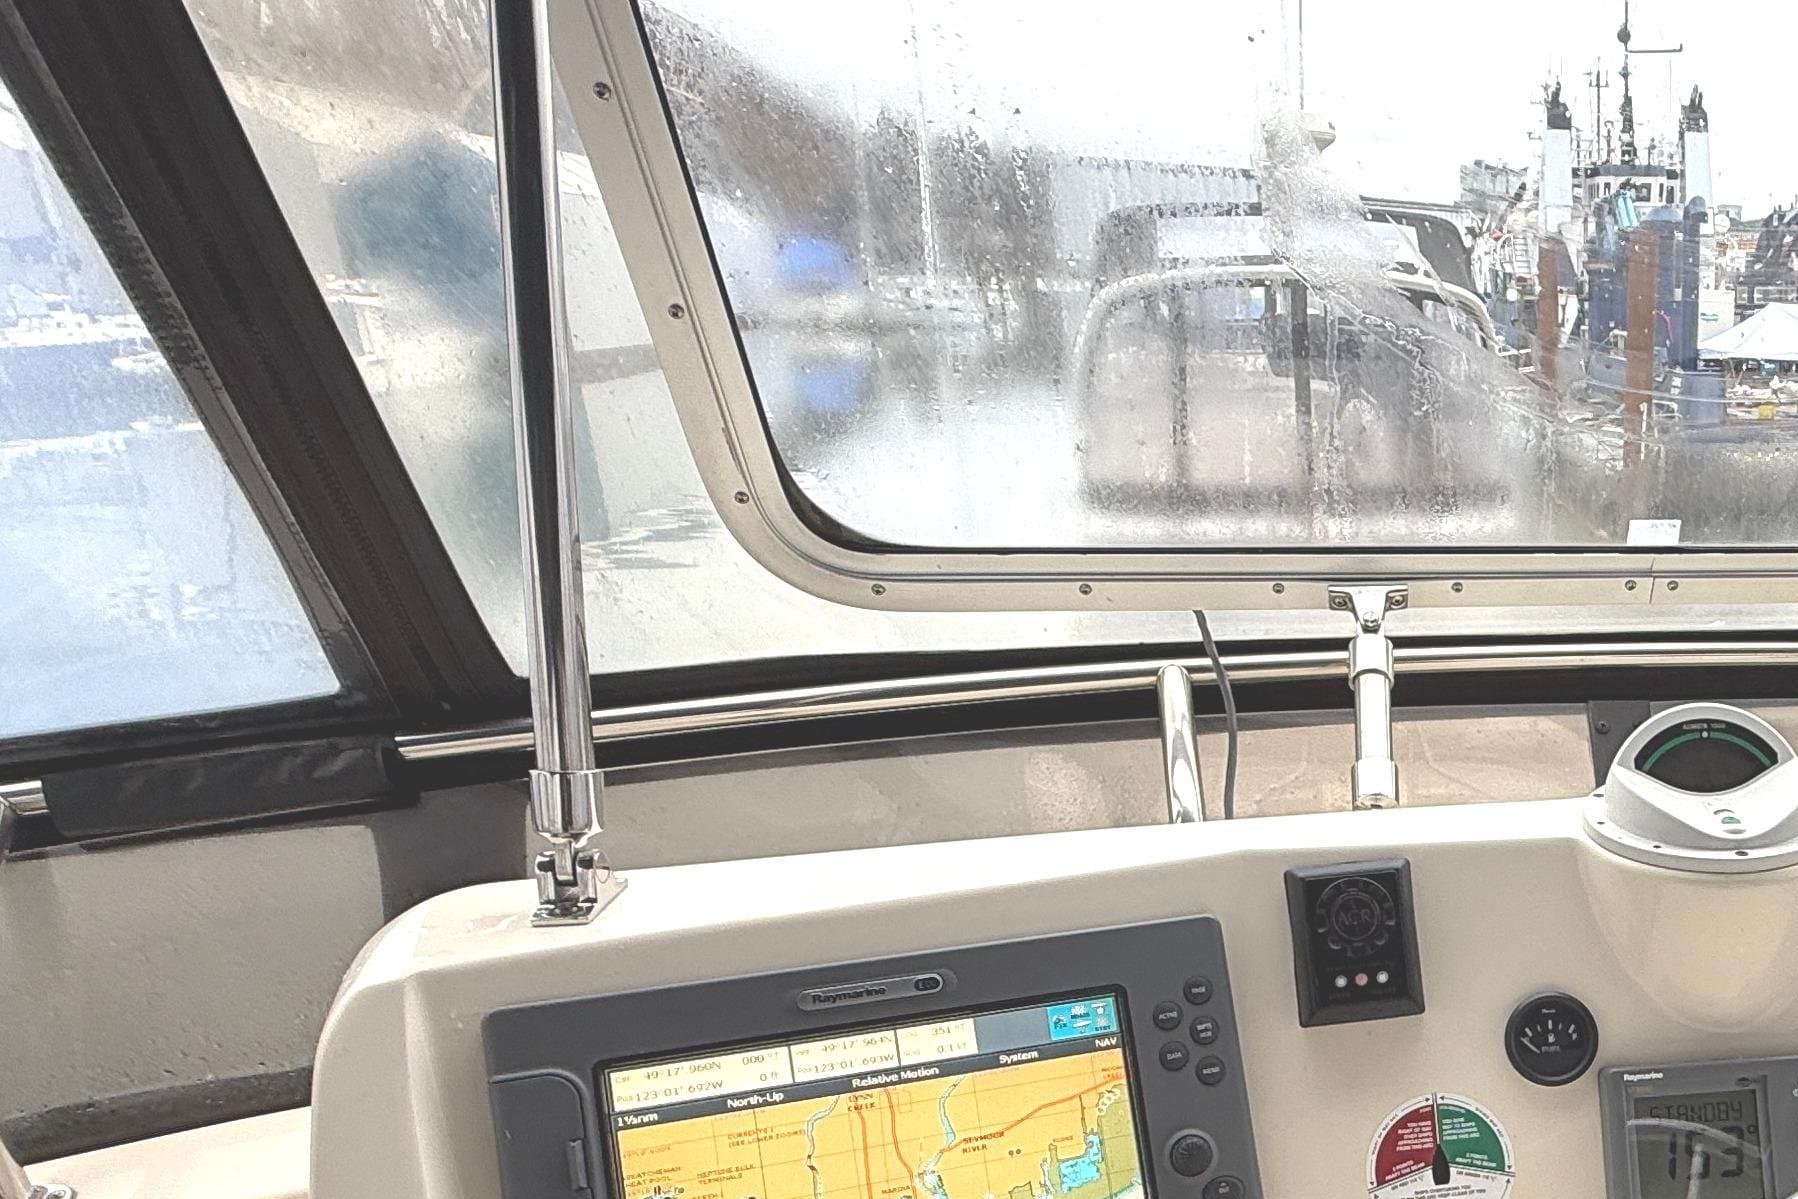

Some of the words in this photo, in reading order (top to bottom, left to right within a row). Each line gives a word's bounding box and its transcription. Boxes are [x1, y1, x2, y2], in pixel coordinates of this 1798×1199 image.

[812, 986, 887, 1004] Raymarine
[727, 1092, 784, 1109] North-Up
[852, 1072, 899, 1088] Relative
[900, 1066, 939, 1081] Motion
[999, 1050, 1039, 1064] System
[1095, 1036, 1117, 1047] NAV
[1623, 1071, 1664, 1082] Raymarine
[1650, 1102, 1743, 1123] STANDBY
